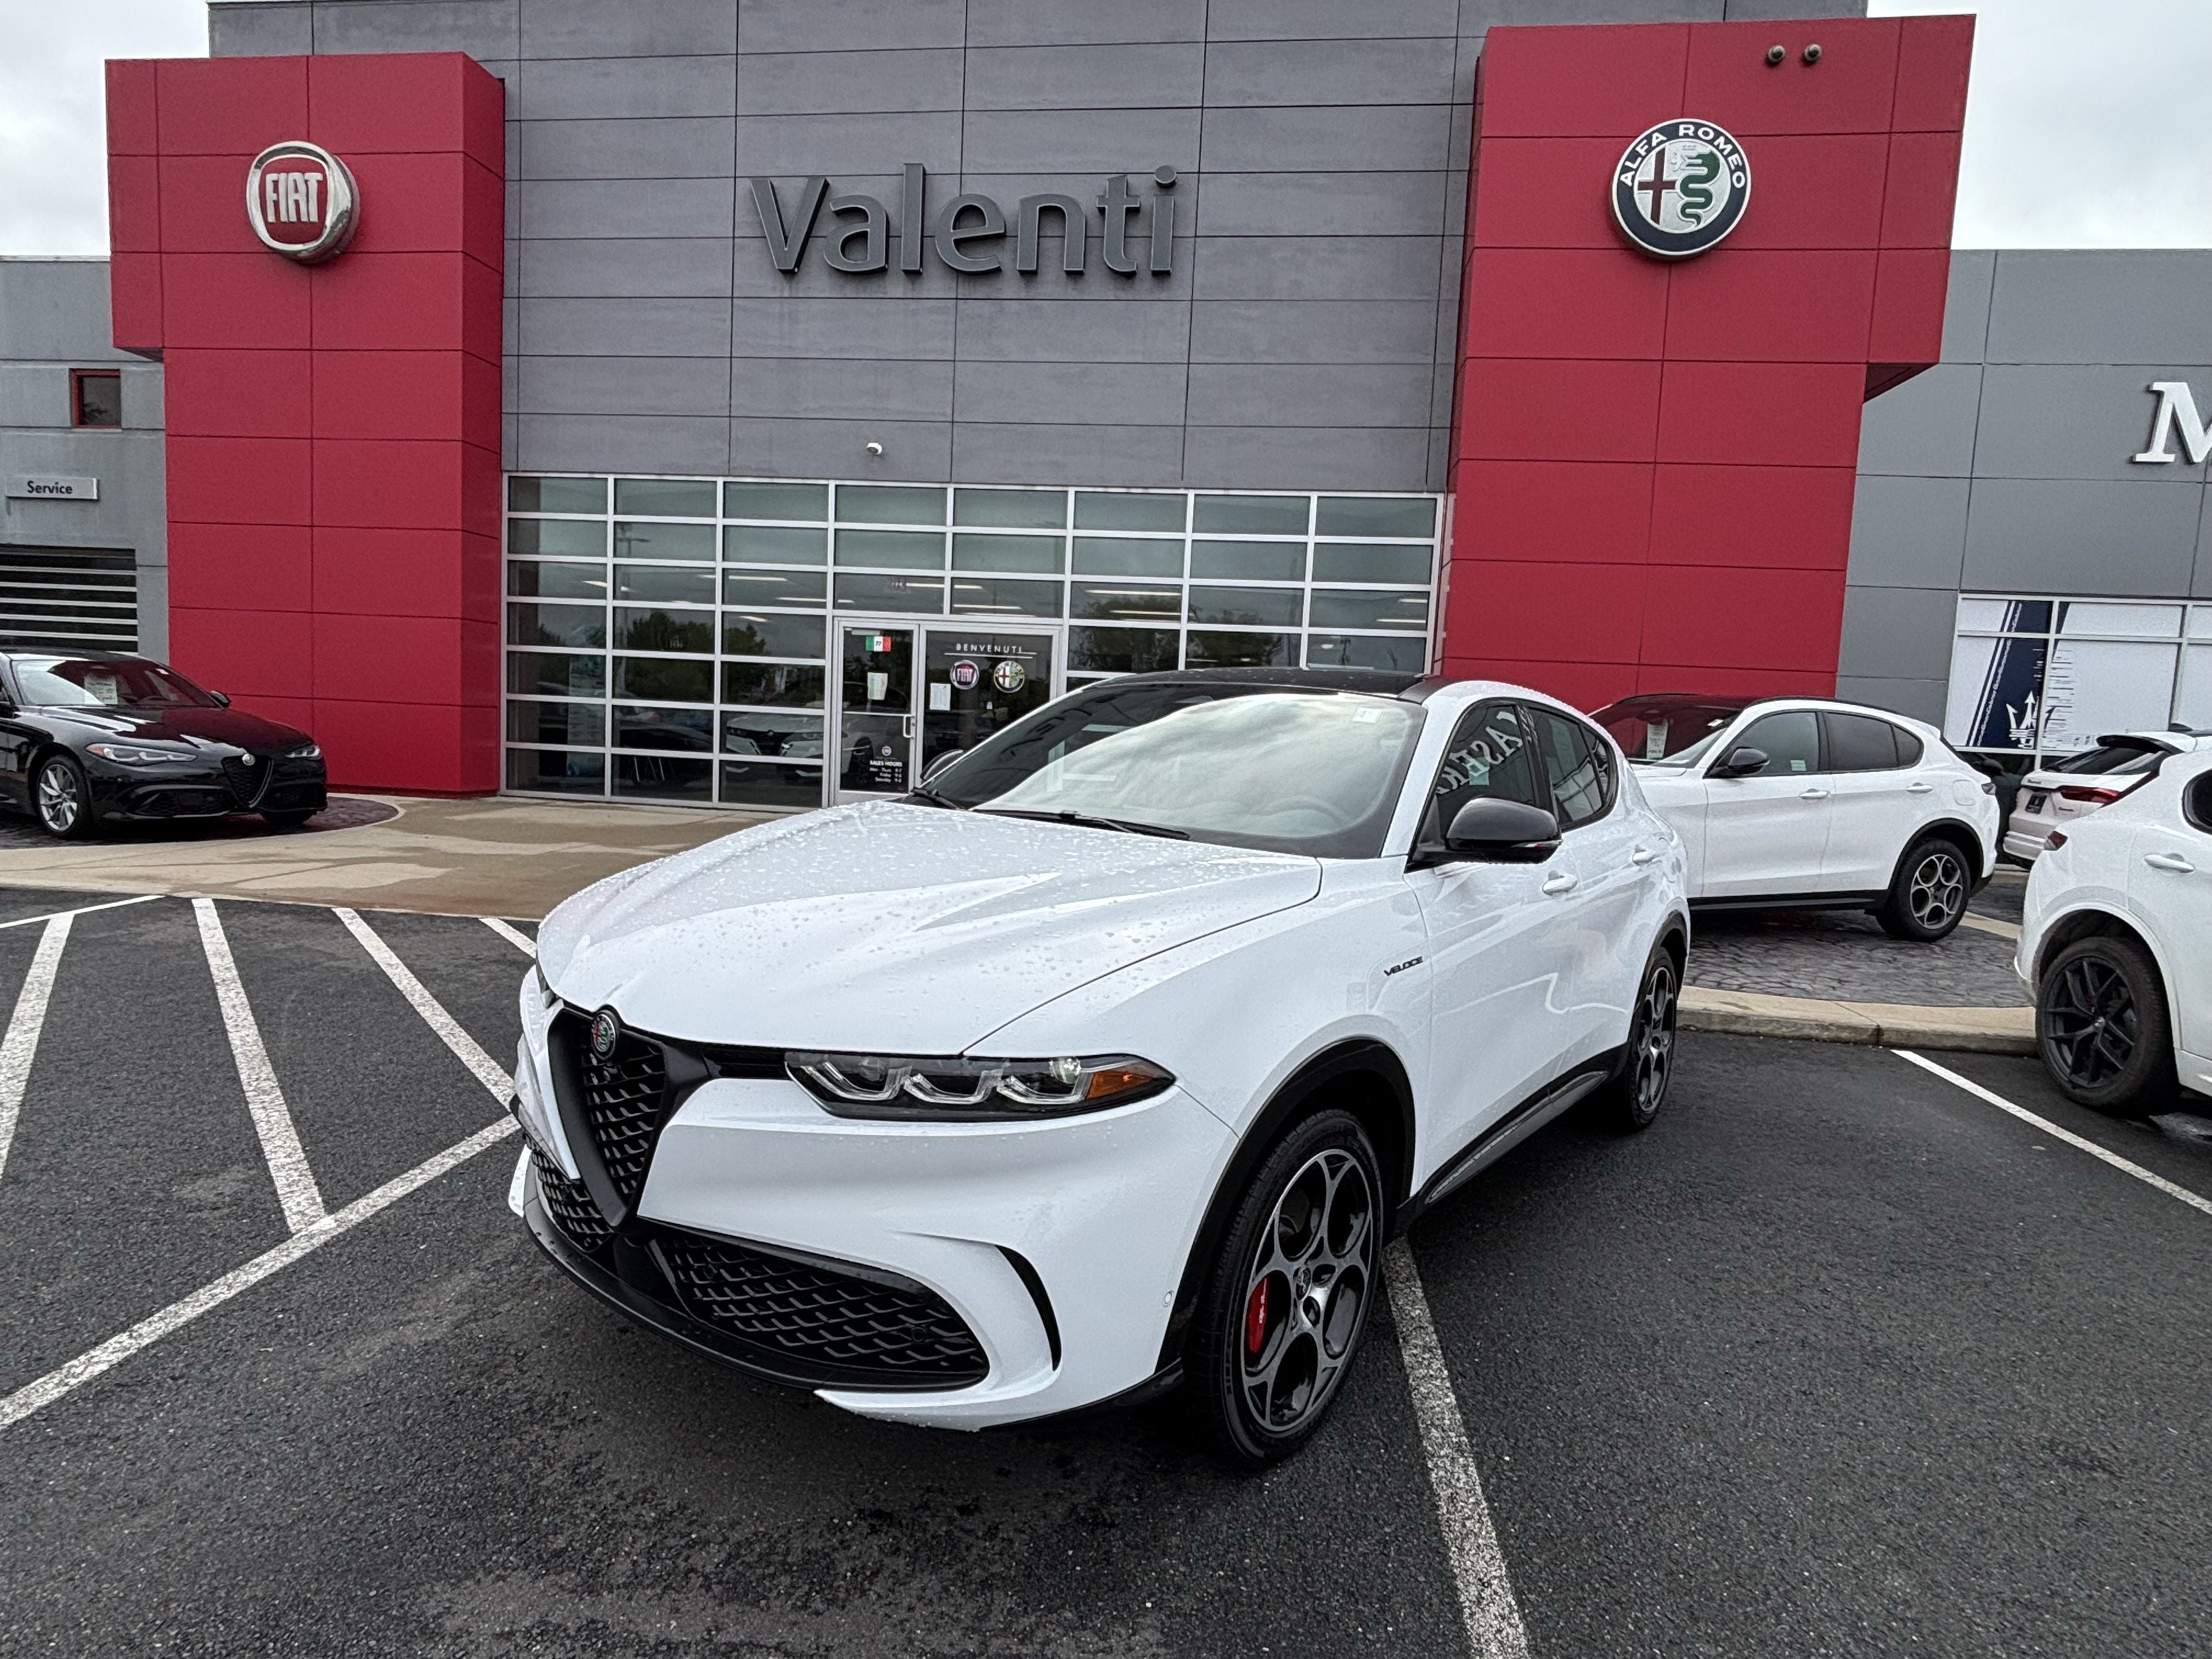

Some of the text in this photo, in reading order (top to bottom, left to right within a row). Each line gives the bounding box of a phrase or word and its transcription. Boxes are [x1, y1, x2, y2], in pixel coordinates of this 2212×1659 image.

[1620, 124, 1746, 189] ALFA ROMEO
[266, 173, 323, 223] FIAT
[749, 163, 1177, 276] Valenti
[26, 480, 73, 495] Service
[956, 643, 1023, 653] BENVENUTI
[957, 668, 973, 682] FIAT
[1384, 956, 1424, 977] VELOCE
